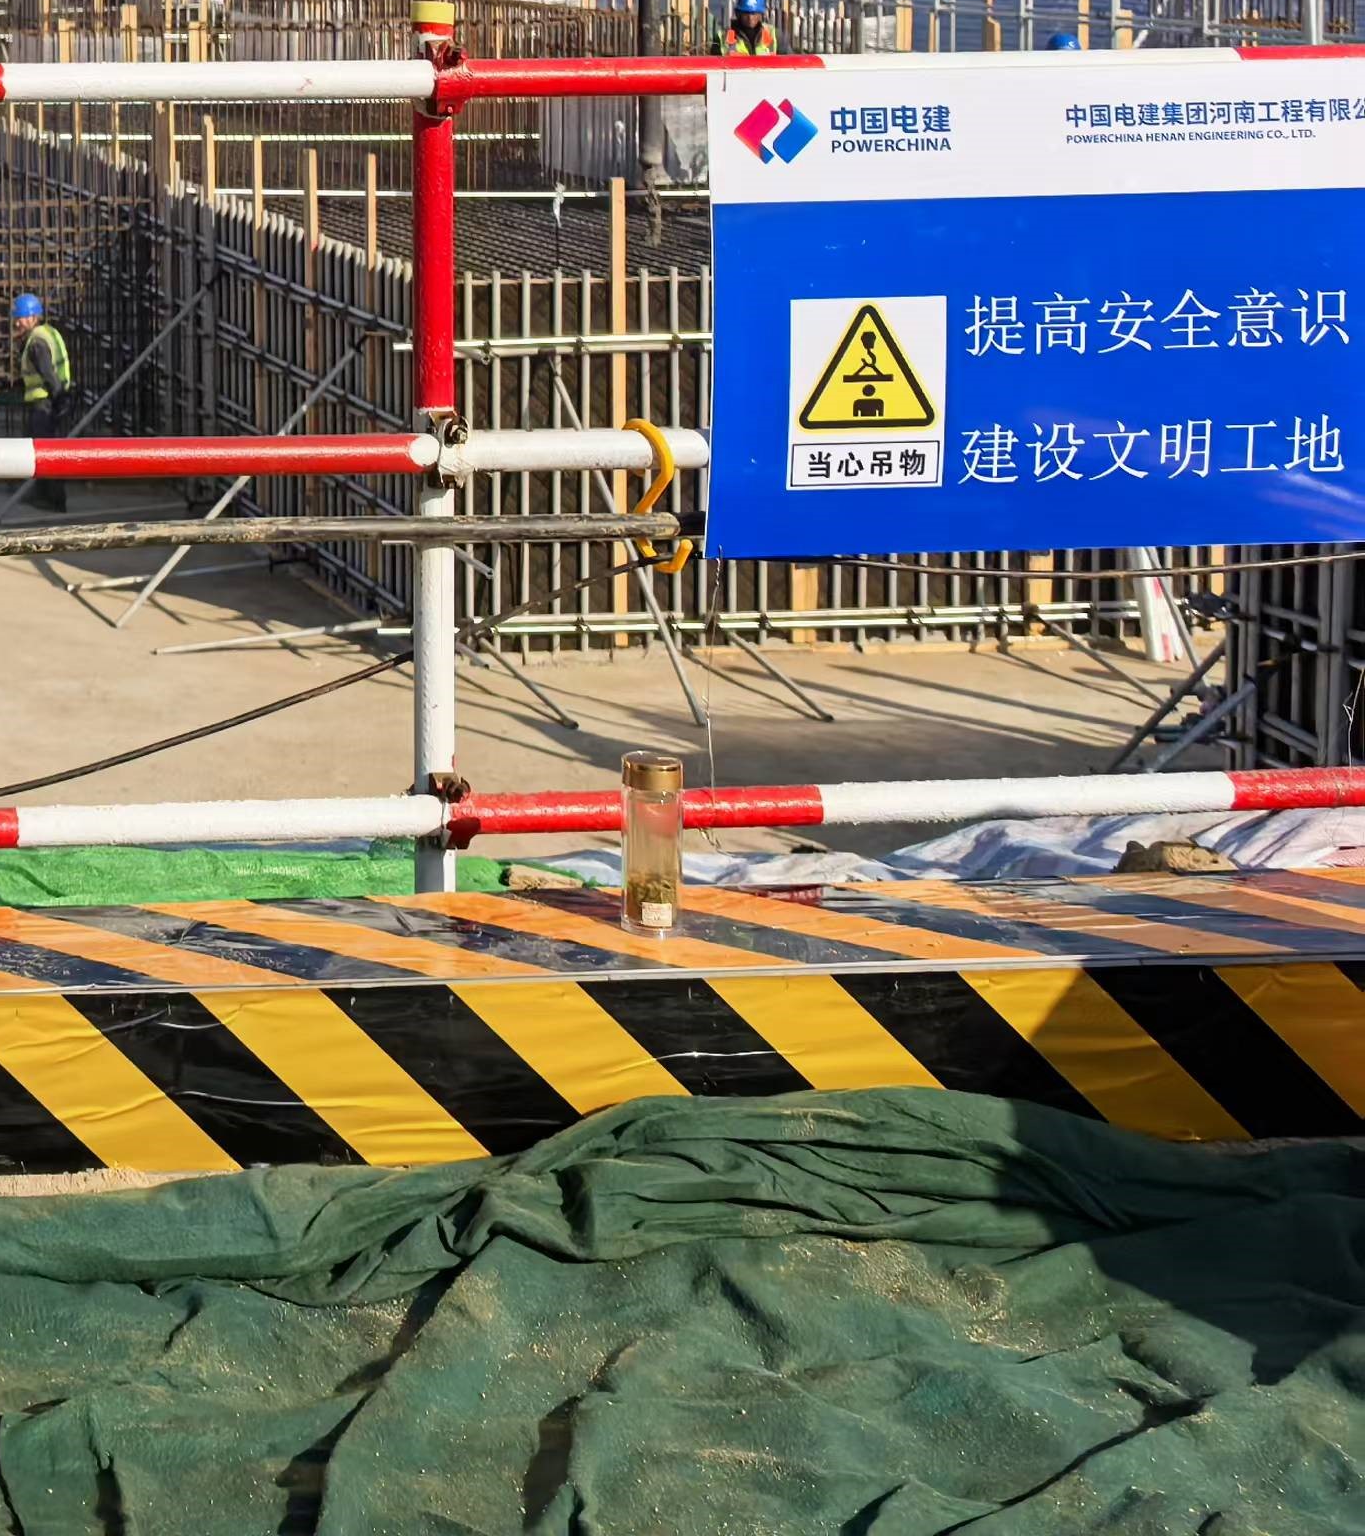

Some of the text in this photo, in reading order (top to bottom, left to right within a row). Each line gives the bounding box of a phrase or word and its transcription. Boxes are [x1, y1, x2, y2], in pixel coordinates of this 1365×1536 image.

[830, 105, 952, 134] 中国电建
[831, 137, 952, 153] POWERCHINA
[1066, 132, 1143, 144] POWERCHINA
[1146, 132, 1186, 142] HENAN
[1188, 129, 1264, 141] ENGINEERING
[964, 286, 1351, 357] 提高安全意识
[957, 413, 1346, 485] 建设文明工地
[807, 449, 927, 479] 当心吊物
